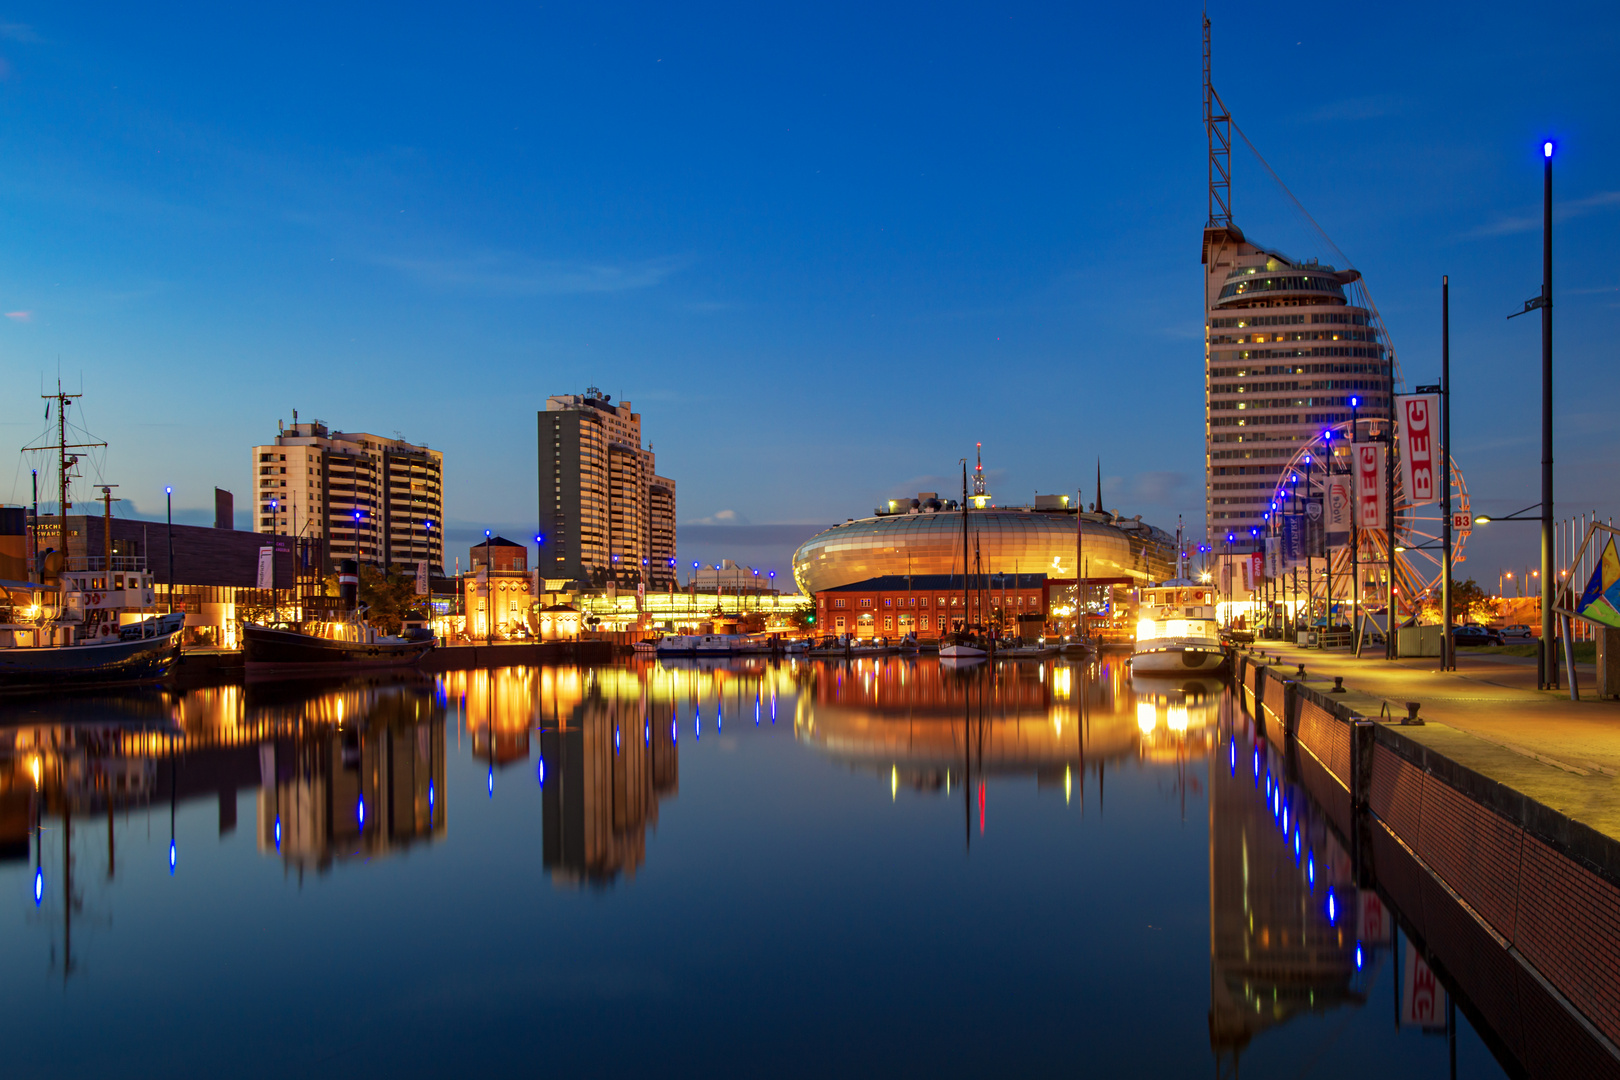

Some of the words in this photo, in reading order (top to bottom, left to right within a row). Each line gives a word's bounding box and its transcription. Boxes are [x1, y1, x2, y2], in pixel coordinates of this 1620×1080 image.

[1362, 447, 1378, 526] BEG
[1408, 400, 1431, 498] BEG
[1454, 516, 1470, 526] B3
